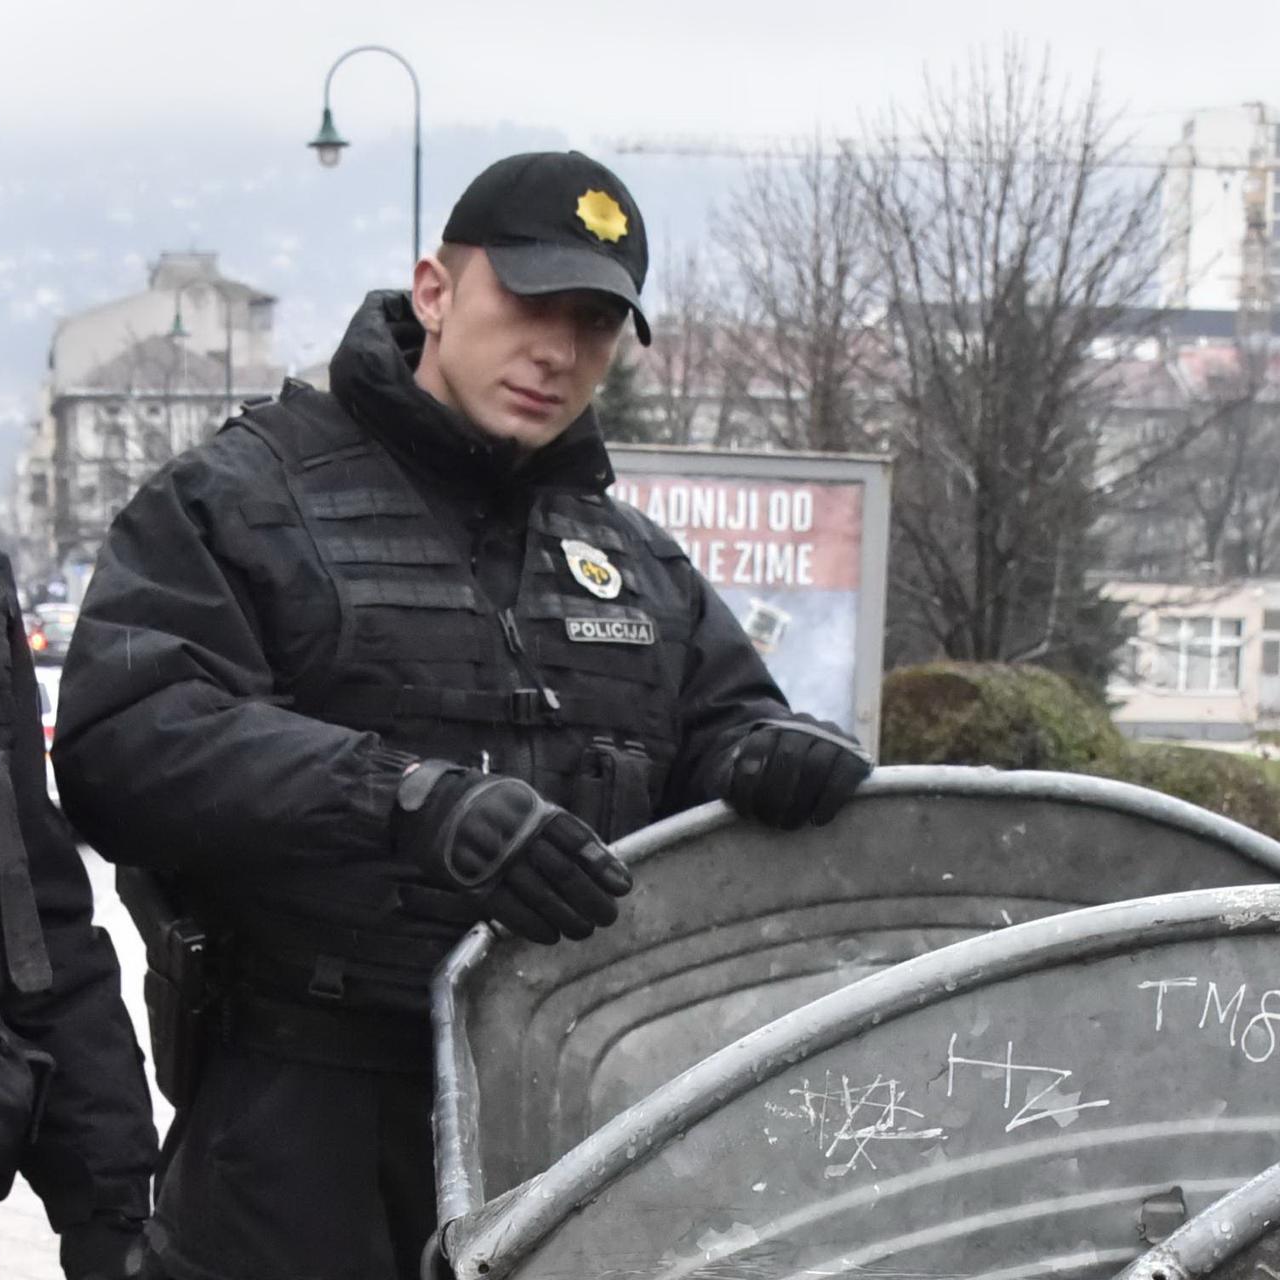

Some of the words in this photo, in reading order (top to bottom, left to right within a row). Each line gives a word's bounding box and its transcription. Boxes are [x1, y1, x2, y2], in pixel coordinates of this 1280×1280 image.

[769, 489, 813, 532] OD
[733, 541, 814, 585] ZIME
[569, 622, 649, 641] POLICIJA
